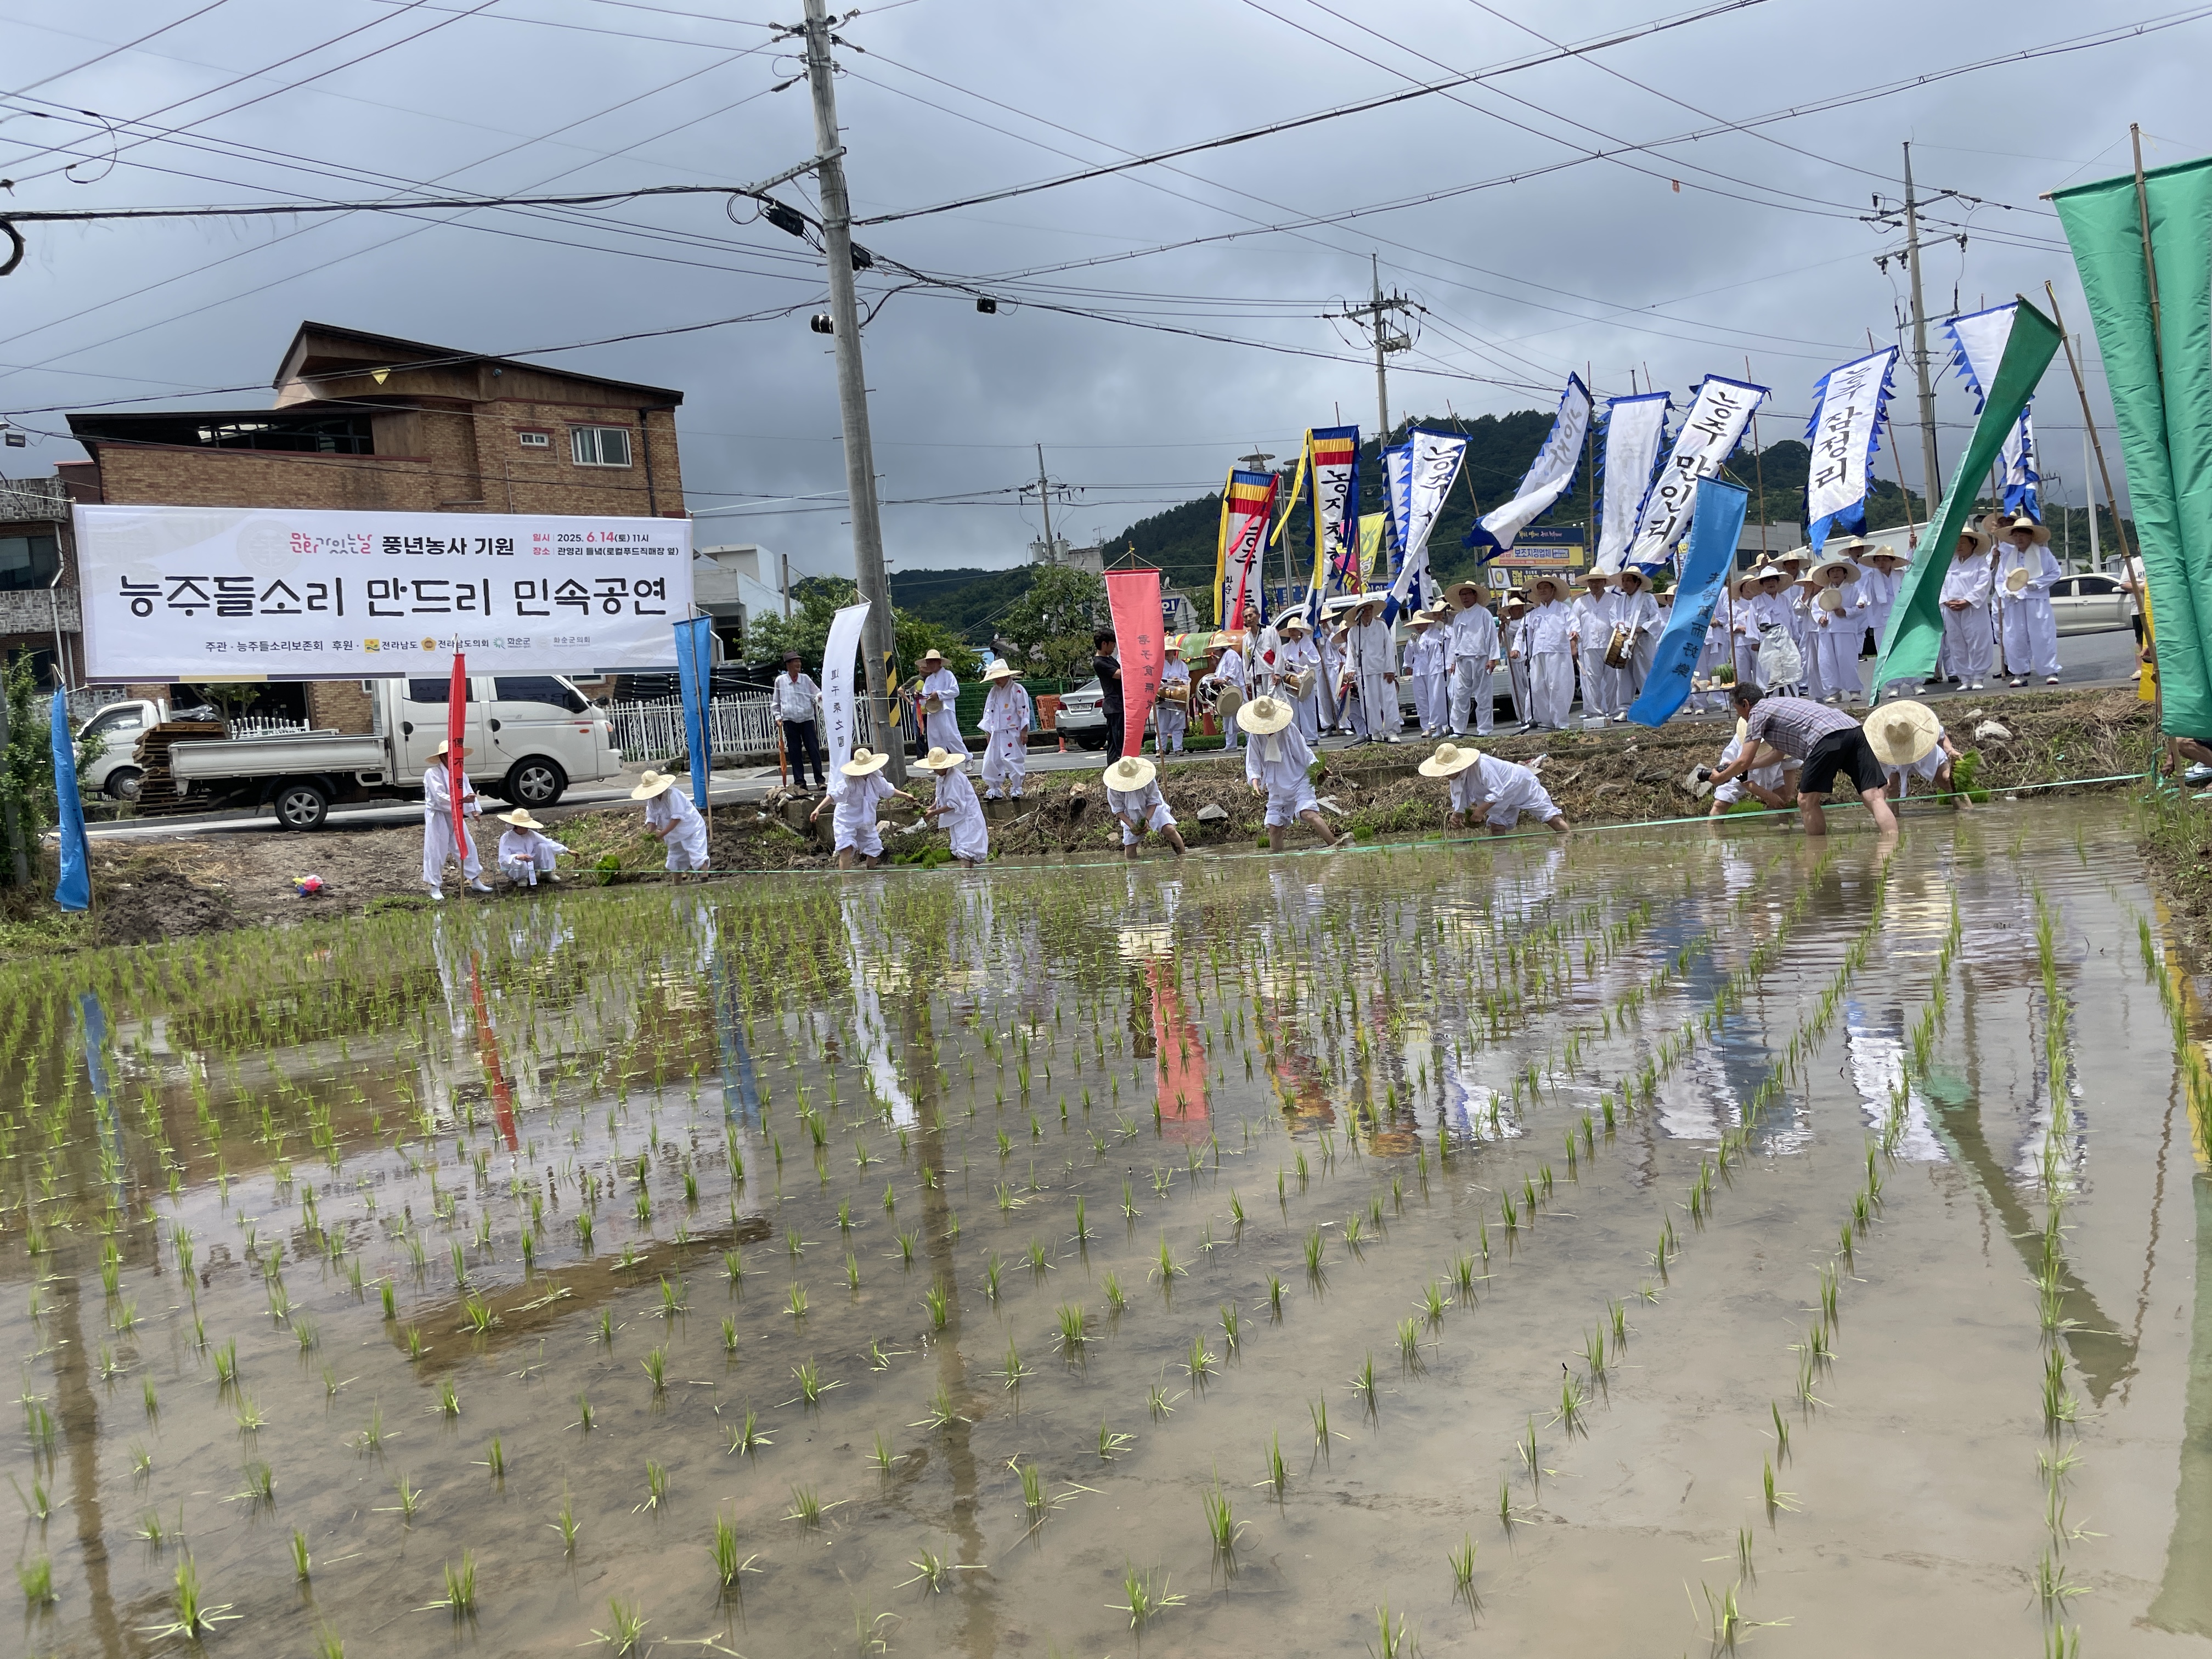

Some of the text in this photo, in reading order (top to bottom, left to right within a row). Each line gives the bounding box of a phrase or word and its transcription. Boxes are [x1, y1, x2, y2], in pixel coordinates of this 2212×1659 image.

[1815, 366, 1872, 488] 능주 잠정리
[1648, 391, 1742, 545] 능주 만인리
[533, 533, 550, 542] 일시
[557, 534, 584, 543] 2025.
[633, 534, 649, 543] 11시
[382, 536, 467, 555] 풍년농사
[475, 537, 515, 556] 기원
[533, 547, 550, 556] 장소
[557, 547, 583, 556] 관영리
[1515, 548, 1551, 558] 보조지정업체
[1225, 575, 1233, 595] 화순
[119, 574, 667, 617] 능주들소리 만드리 민속공연
[205, 640, 353, 652] 주관 능주들소리보존회 후원
[382, 640, 419, 650] 전라남도
[507, 637, 531, 645] 화순군
